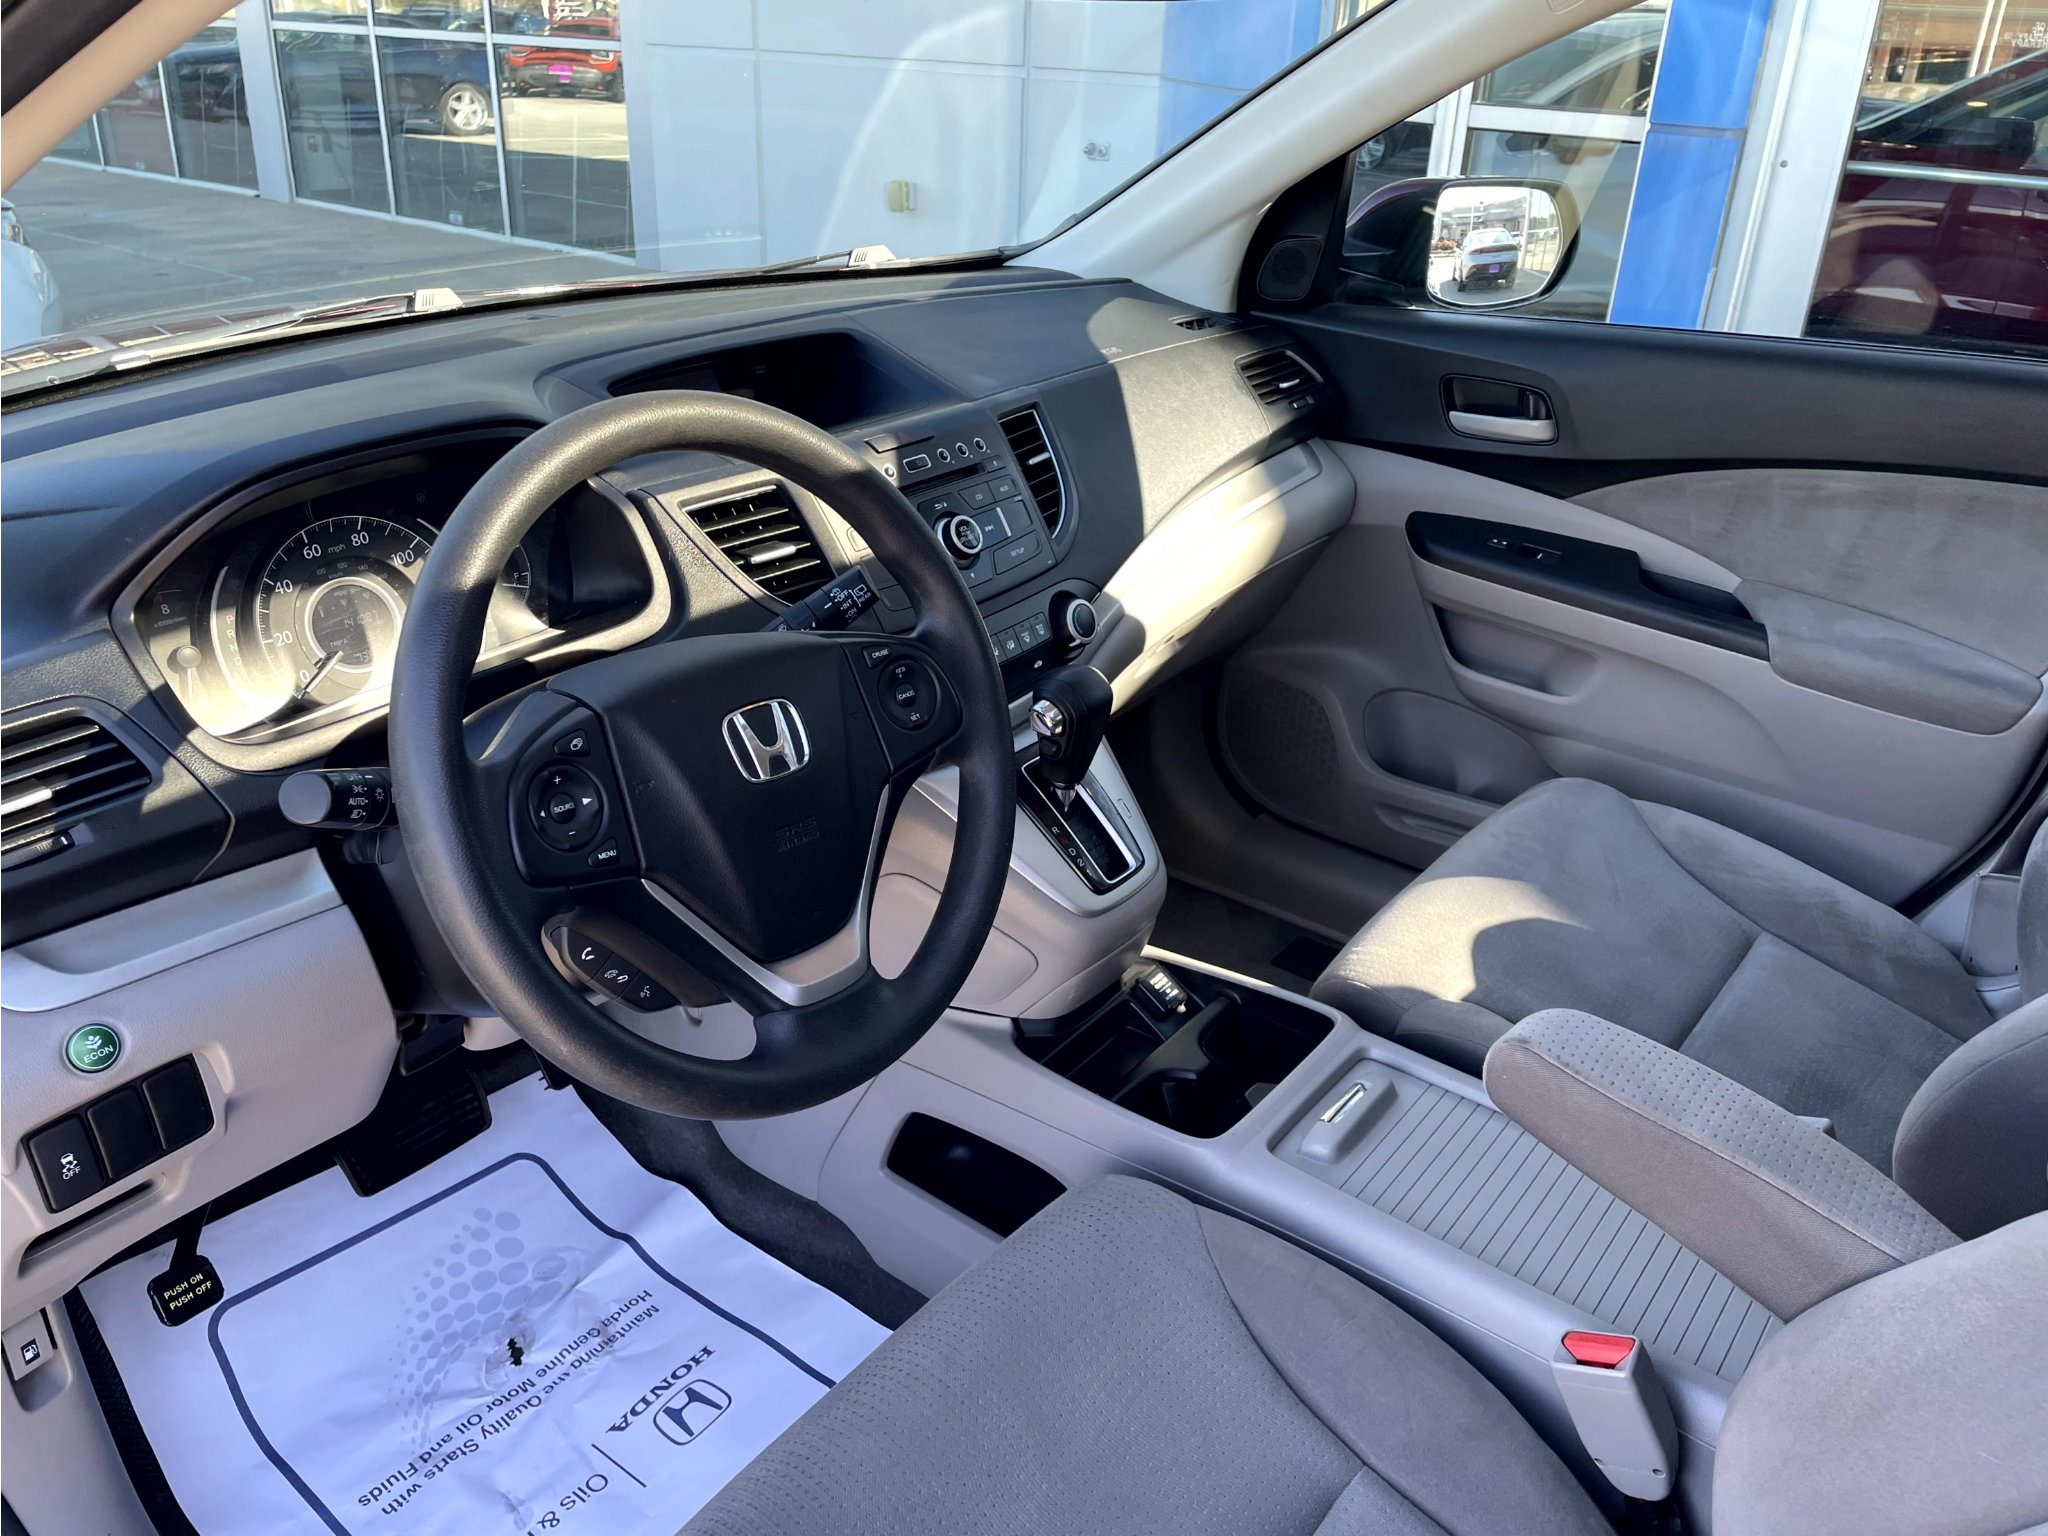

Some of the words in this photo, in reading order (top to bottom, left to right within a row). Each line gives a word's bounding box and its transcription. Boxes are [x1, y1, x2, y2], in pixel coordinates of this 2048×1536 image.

[350, 531, 370, 547] 80
[303, 543, 322, 559] 60
[328, 543, 346, 554] mph
[390, 550, 415, 566] 100
[274, 579, 293, 595] 40
[838, 590, 849, 602] OFF
[842, 598, 853, 610] INT
[160, 604, 170, 615] 8
[848, 607, 858, 617] ON
[226, 614, 234, 624] P
[226, 630, 236, 639] R
[274, 630, 293, 647] 20
[872, 648, 889, 659] CRUISE
[348, 798, 366, 806] AUTO
[1052, 826, 1061, 835] R
[598, 849, 617, 860] MENU
[1068, 848, 1077, 856] D
[1076, 858, 1085, 867] 2
[84, 1044, 114, 1064] ECON
[62, 1166, 81, 1181] OFF
[163, 1281, 189, 1300] PUSH
[190, 1272, 205, 1286] ON
[169, 1292, 195, 1311] PUSH
[194, 1280, 213, 1297] OFF
[601, 1289, 654, 1328] Honda
[535, 1327, 601, 1378] Genuine
[486, 1378, 537, 1414] Motor
[605, 1345, 717, 1434] HONDA
[456, 1414, 483, 1435] Oil
[480, 1395, 542, 1440] Quality
[418, 1433, 453, 1464] and
[424, 1438, 480, 1480] Starts
[358, 1462, 420, 1507] Fluids
[560, 1474, 608, 1511] Oils
[381, 1483, 423, 1515] with
[536, 1510, 560, 1530] &
